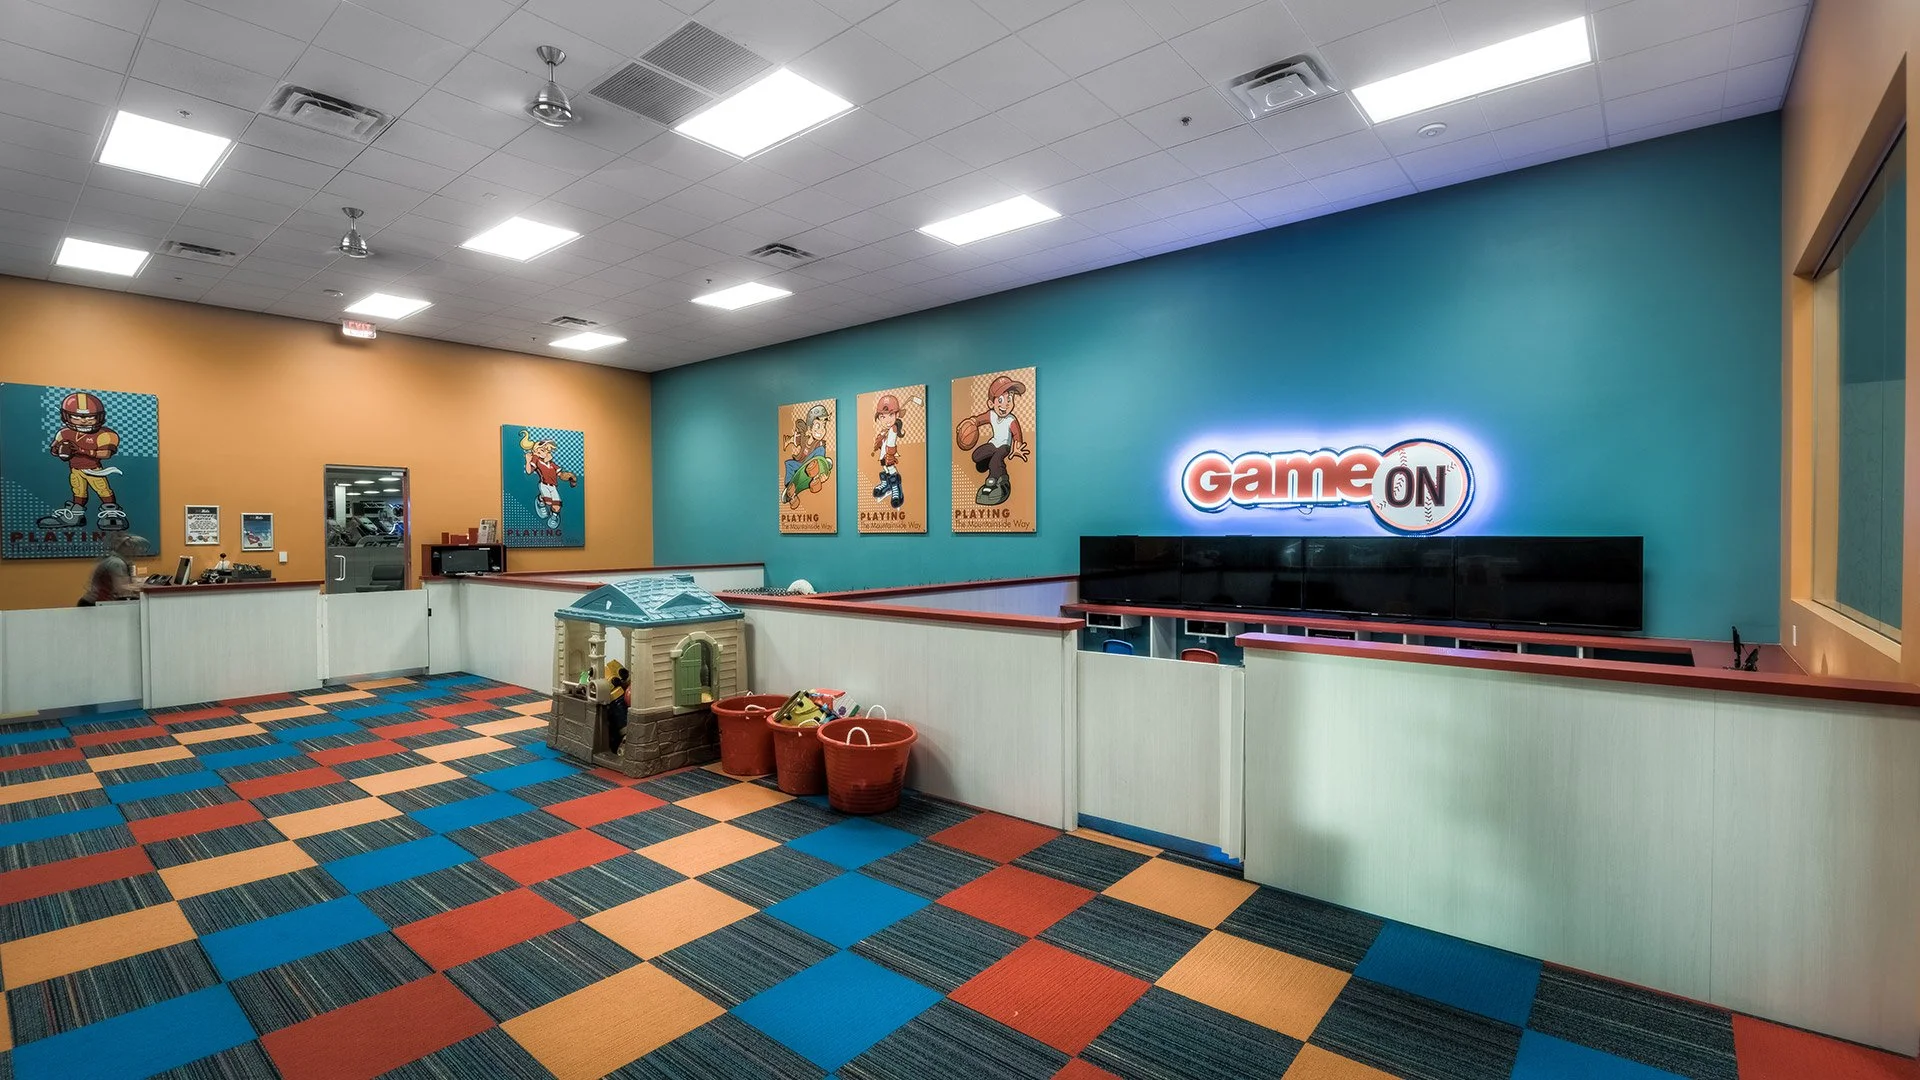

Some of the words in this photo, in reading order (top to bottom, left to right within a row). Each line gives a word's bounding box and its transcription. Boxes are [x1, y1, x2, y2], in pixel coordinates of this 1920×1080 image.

[348, 321, 371, 331] EXIT
[1385, 465, 1446, 508] ON
[781, 514, 819, 522] PLAYING
[860, 511, 906, 521] PLAYING
[955, 508, 1011, 519] PLAYING
[820, 522, 833, 531] Way
[860, 521, 870, 529] The
[908, 521, 921, 531] Way
[955, 519, 966, 528] The
[1013, 519, 1030, 530] Way
[9, 531, 107, 543] PLAYIN
[506, 529, 562, 537] PLAYING
